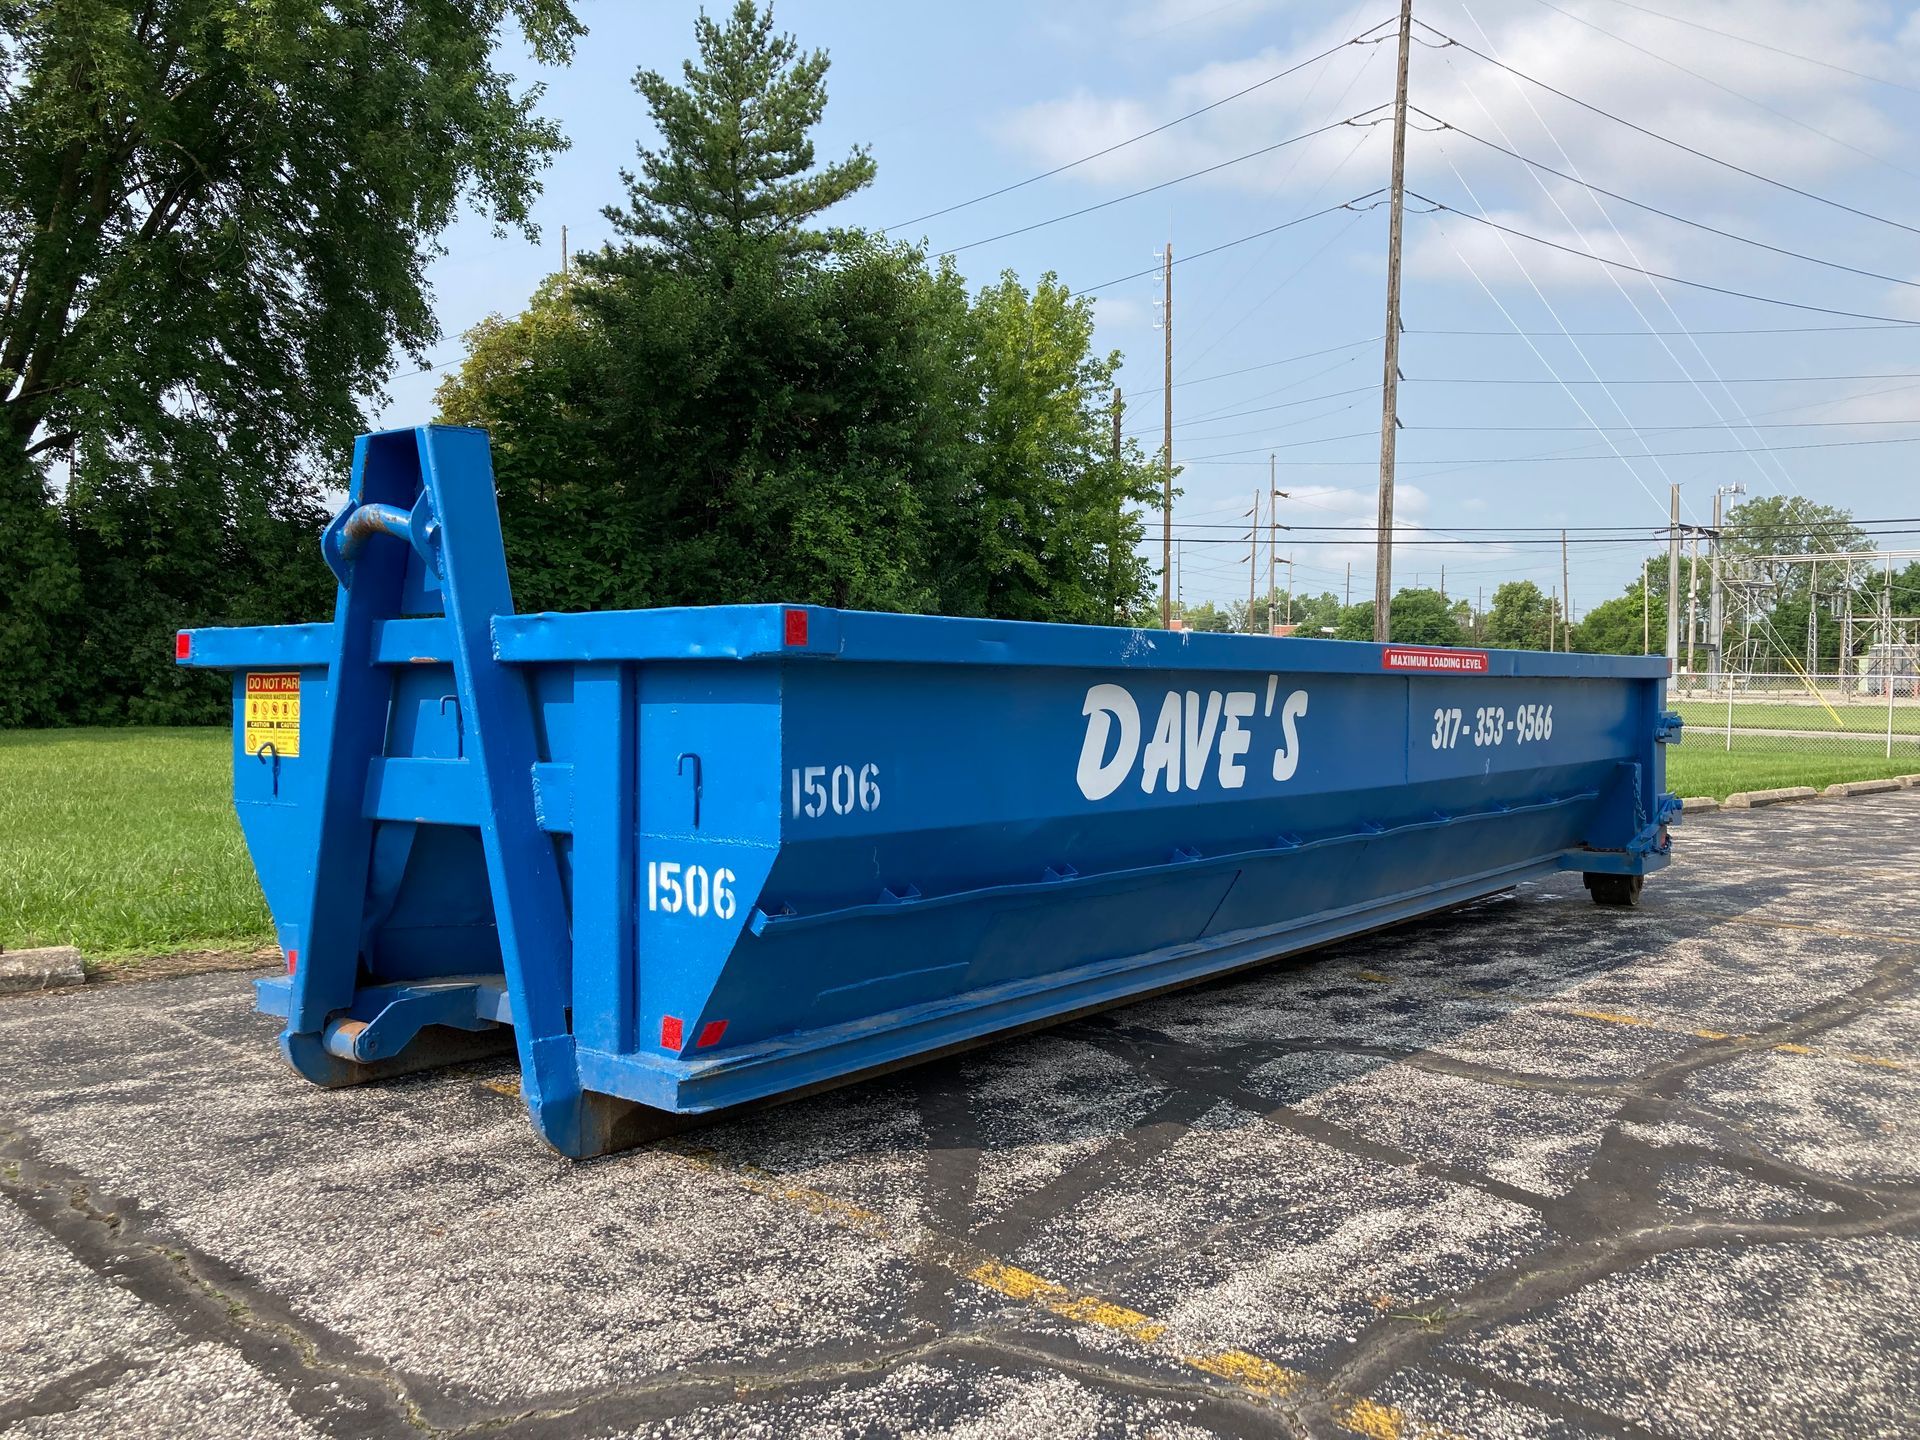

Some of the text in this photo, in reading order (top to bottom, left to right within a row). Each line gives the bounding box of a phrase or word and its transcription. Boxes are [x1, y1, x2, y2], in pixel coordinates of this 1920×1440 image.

[248, 677, 261, 690] DO
[262, 677, 280, 690] NOT
[1390, 655, 1482, 669] MAXIMUM LOADING LEVEL
[1076, 674, 1309, 801] DAVE'S
[791, 763, 881, 820] 1506
[648, 861, 736, 920] 1506
